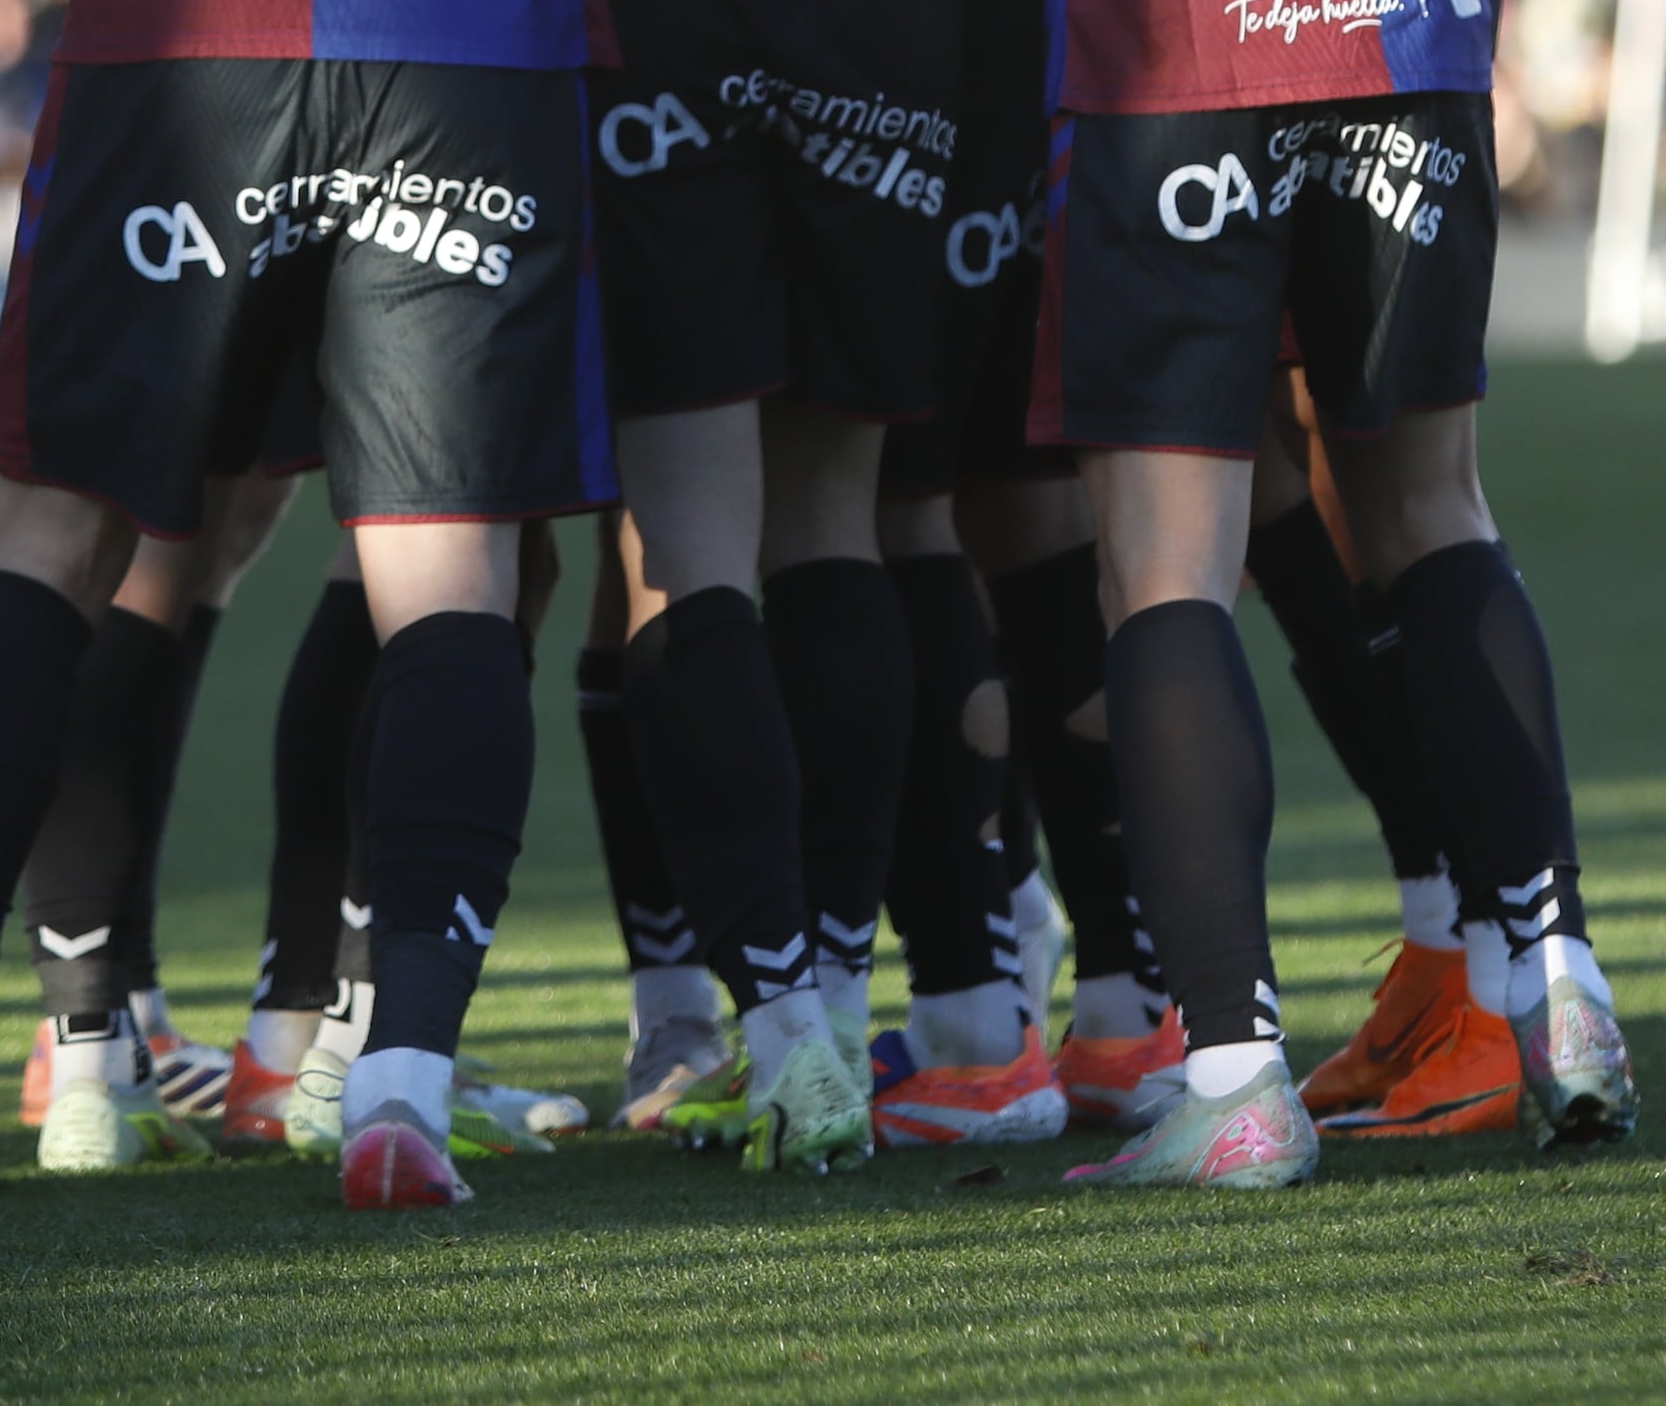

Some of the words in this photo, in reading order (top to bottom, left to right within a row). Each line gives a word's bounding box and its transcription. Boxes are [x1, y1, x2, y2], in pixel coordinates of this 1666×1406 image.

[598, 92, 710, 177] CA
[719, 69, 957, 161] ceamientos
[1158, 152, 1259, 242] CA
[122, 201, 226, 282] CA
